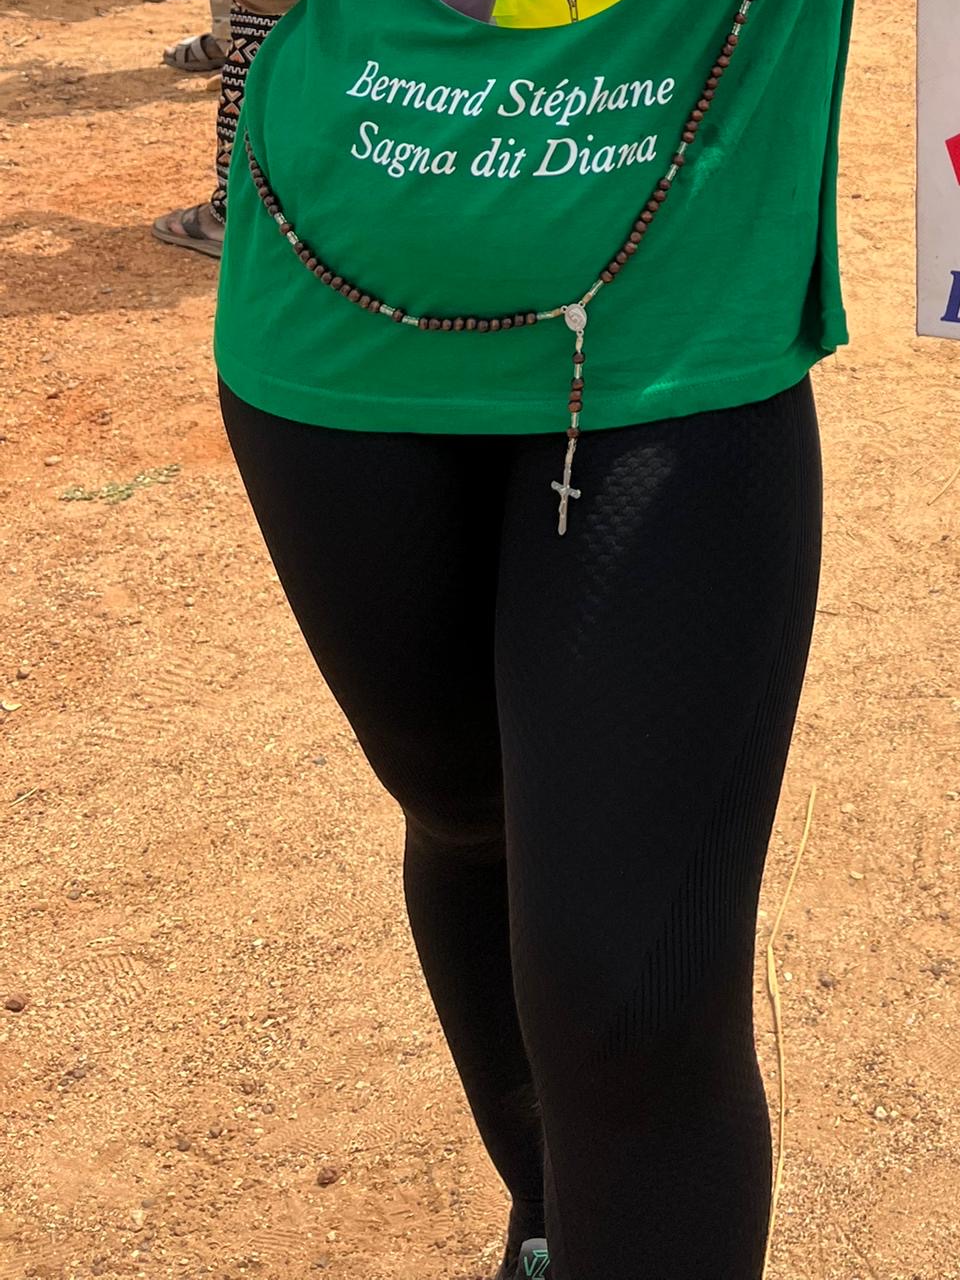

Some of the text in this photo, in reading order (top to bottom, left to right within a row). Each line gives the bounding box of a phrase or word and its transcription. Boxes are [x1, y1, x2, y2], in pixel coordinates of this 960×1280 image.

[346, 60, 676, 126] Bernard Stéphane
[351, 121, 658, 179] Sagna dit Diana
